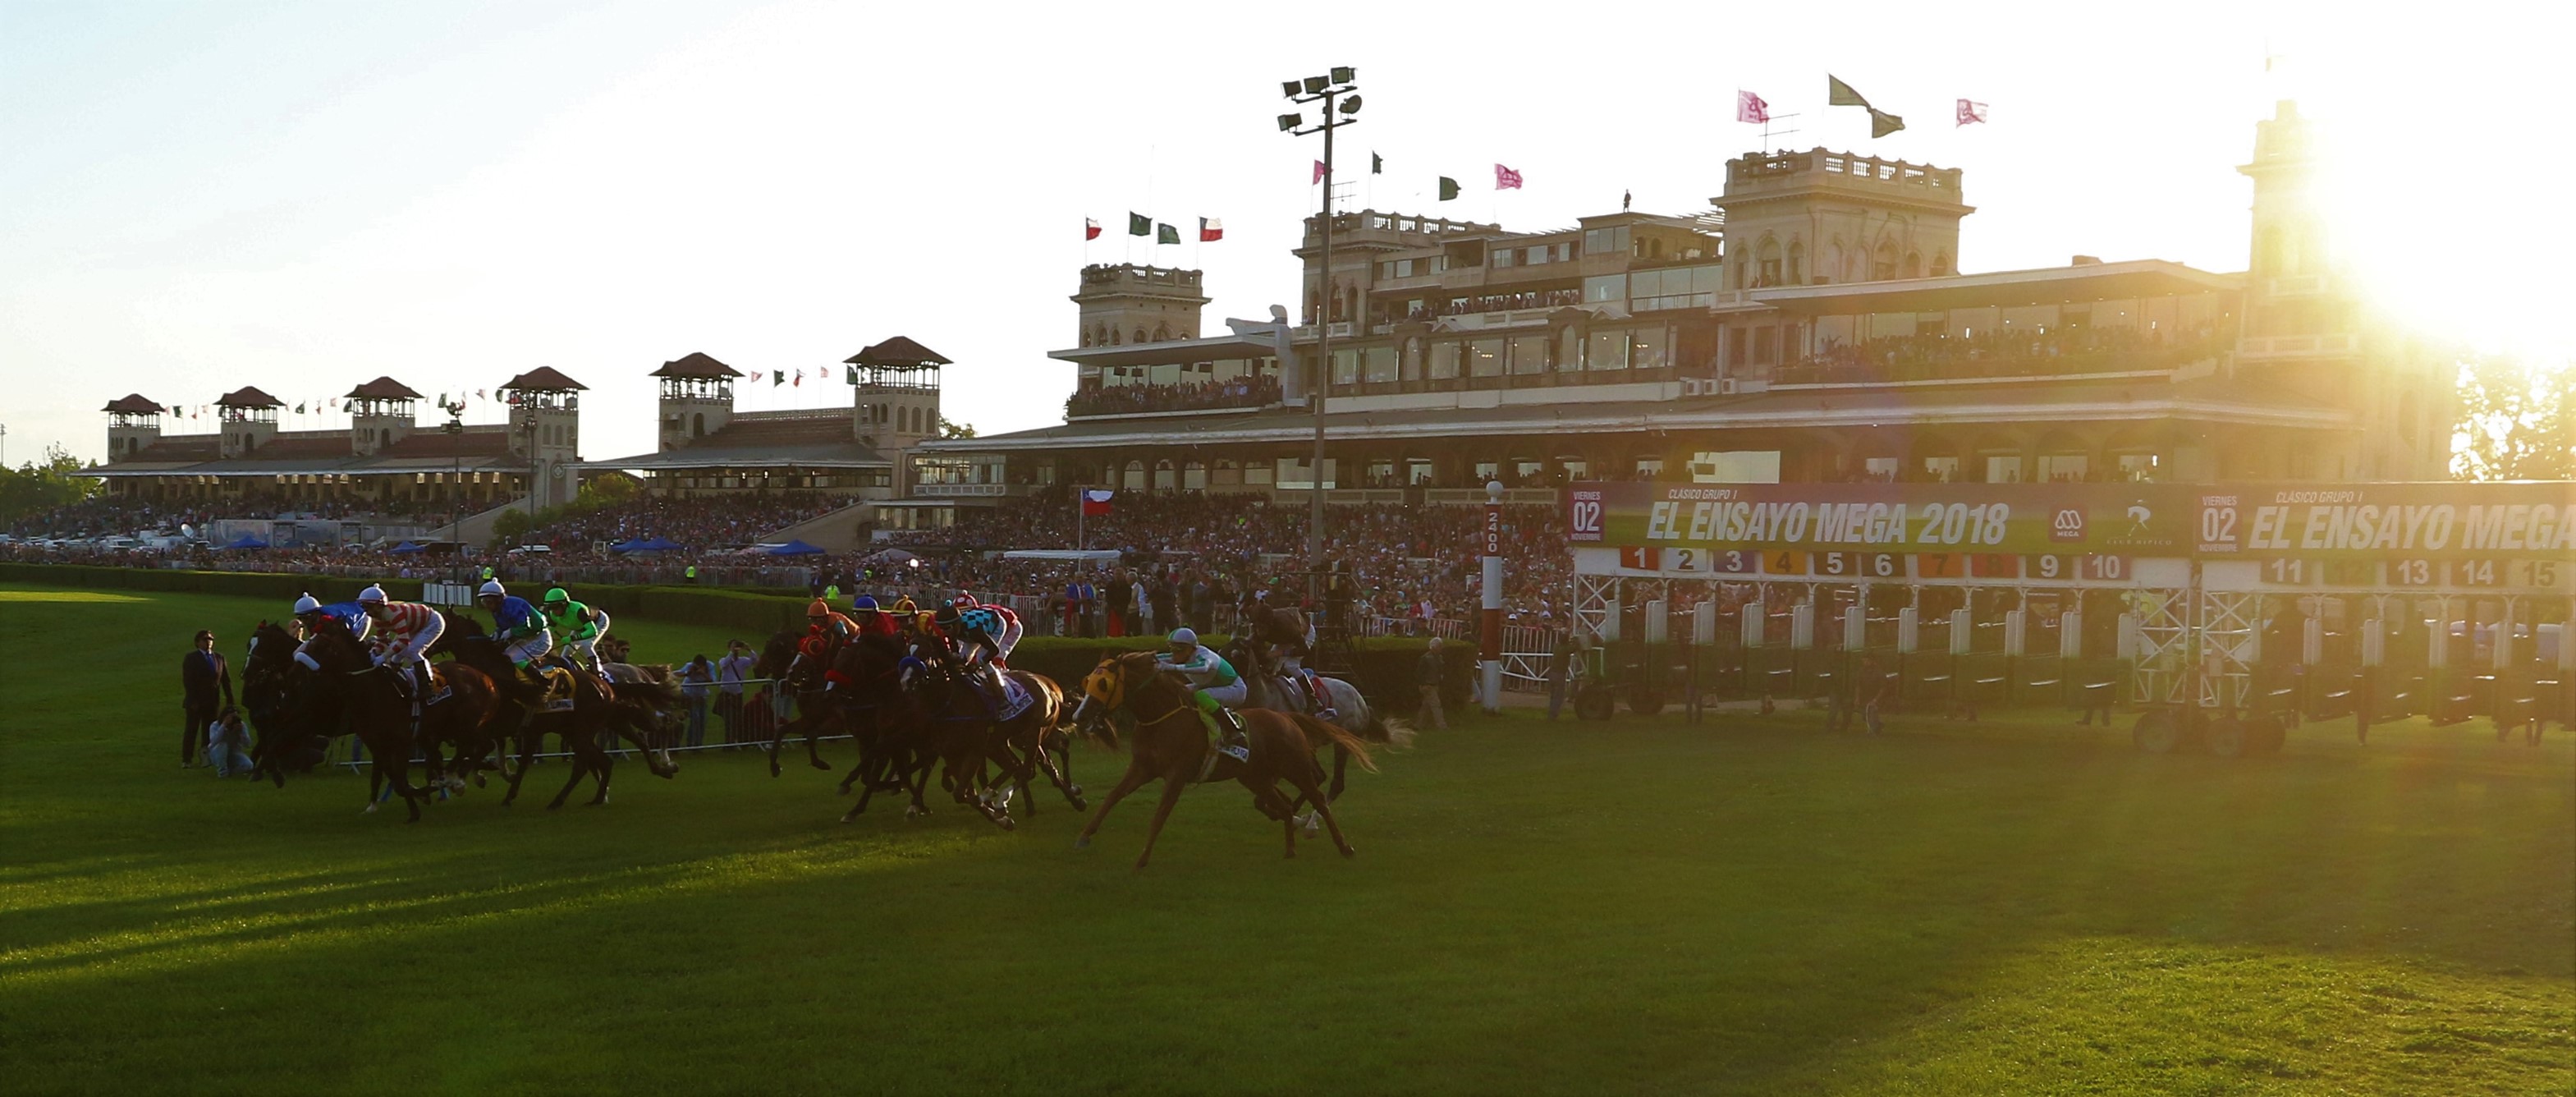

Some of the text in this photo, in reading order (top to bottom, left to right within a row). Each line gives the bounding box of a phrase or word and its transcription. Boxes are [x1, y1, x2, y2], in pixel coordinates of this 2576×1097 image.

[1574, 492, 1601, 500] VIERNES
[1669, 489, 1701, 498] CLÁSICO
[1703, 489, 1730, 498] GRUPO
[2202, 496, 2237, 506] VIERNES
[2276, 491, 2317, 503] CLÁSICO
[2319, 492, 2354, 503] GRUPO
[1573, 502, 1600, 531] 02
[1647, 501, 2010, 545] EL ENSAYO MEGA 2018
[2202, 507, 2236, 542] 02
[2248, 503, 2576, 550] EL ENSAYO MEGA
[1488, 512, 1498, 553] 2400
[1571, 533, 1601, 541] NOVIEMBRE
[1634, 548, 1645, 568] 1
[2199, 544, 2237, 552] NOVIEMBRE
[1678, 549, 1694, 570] 2
[1726, 550, 1743, 572] 3
[1776, 552, 1793, 572] 4
[1827, 553, 1844, 574] 5
[1875, 554, 1893, 576] 6
[1932, 554, 1949, 576] 7
[2040, 554, 2059, 577] 9
[2092, 555, 2120, 579] 10
[2271, 558, 2303, 583] 11
[2398, 560, 2430, 585] 13
[2463, 560, 2494, 585] 14
[2523, 562, 2556, 586] 15
